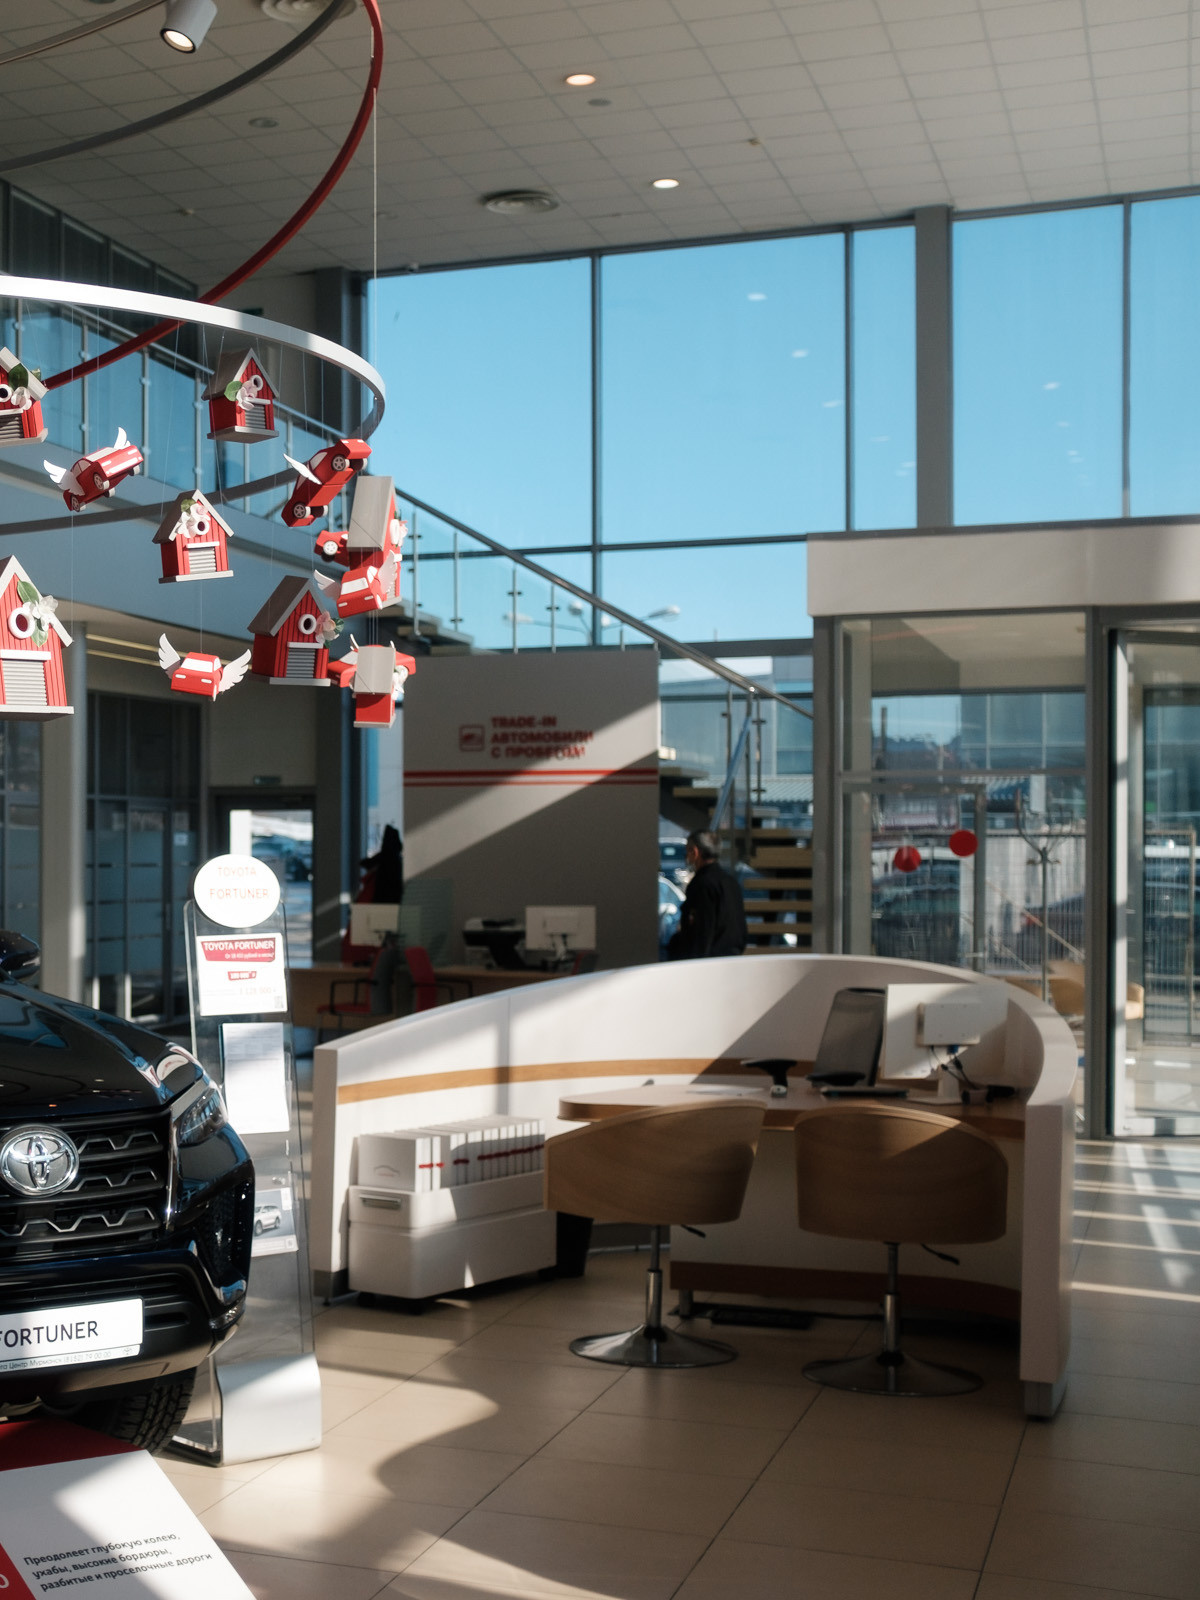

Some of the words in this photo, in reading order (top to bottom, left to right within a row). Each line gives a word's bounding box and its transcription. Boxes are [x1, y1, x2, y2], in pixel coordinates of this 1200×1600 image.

[491, 716, 557, 728] TRADE-IN
[491, 730, 594, 744] АВТОМОБИЛИ
[491, 746, 501, 758] С
[505, 744, 586, 759] ПРОБЕГОМ
[218, 866, 257, 878] TOYOTA
[209, 888, 269, 900] FORTUNER
[203, 941, 234, 951] TOYOTA
[234, 940, 274, 950] FORTUNER
[9, 1360, 28, 1370] Центр
[29, 1357, 62, 1369] Мурманск
[23, 1548, 90, 1567] Преодолеет
[91, 1538, 143, 1555] глубокую
[143, 1532, 181, 1546] колею,
[32, 1565, 72, 1580] ухабы,
[73, 1557, 118, 1571] высокие
[118, 1547, 173, 1563] бордюры,
[40, 1574, 94, 1592] разбитые
[95, 1572, 103, 1581] и
[103, 1560, 175, 1580] проселочные
[176, 1552, 213, 1567] дороги
